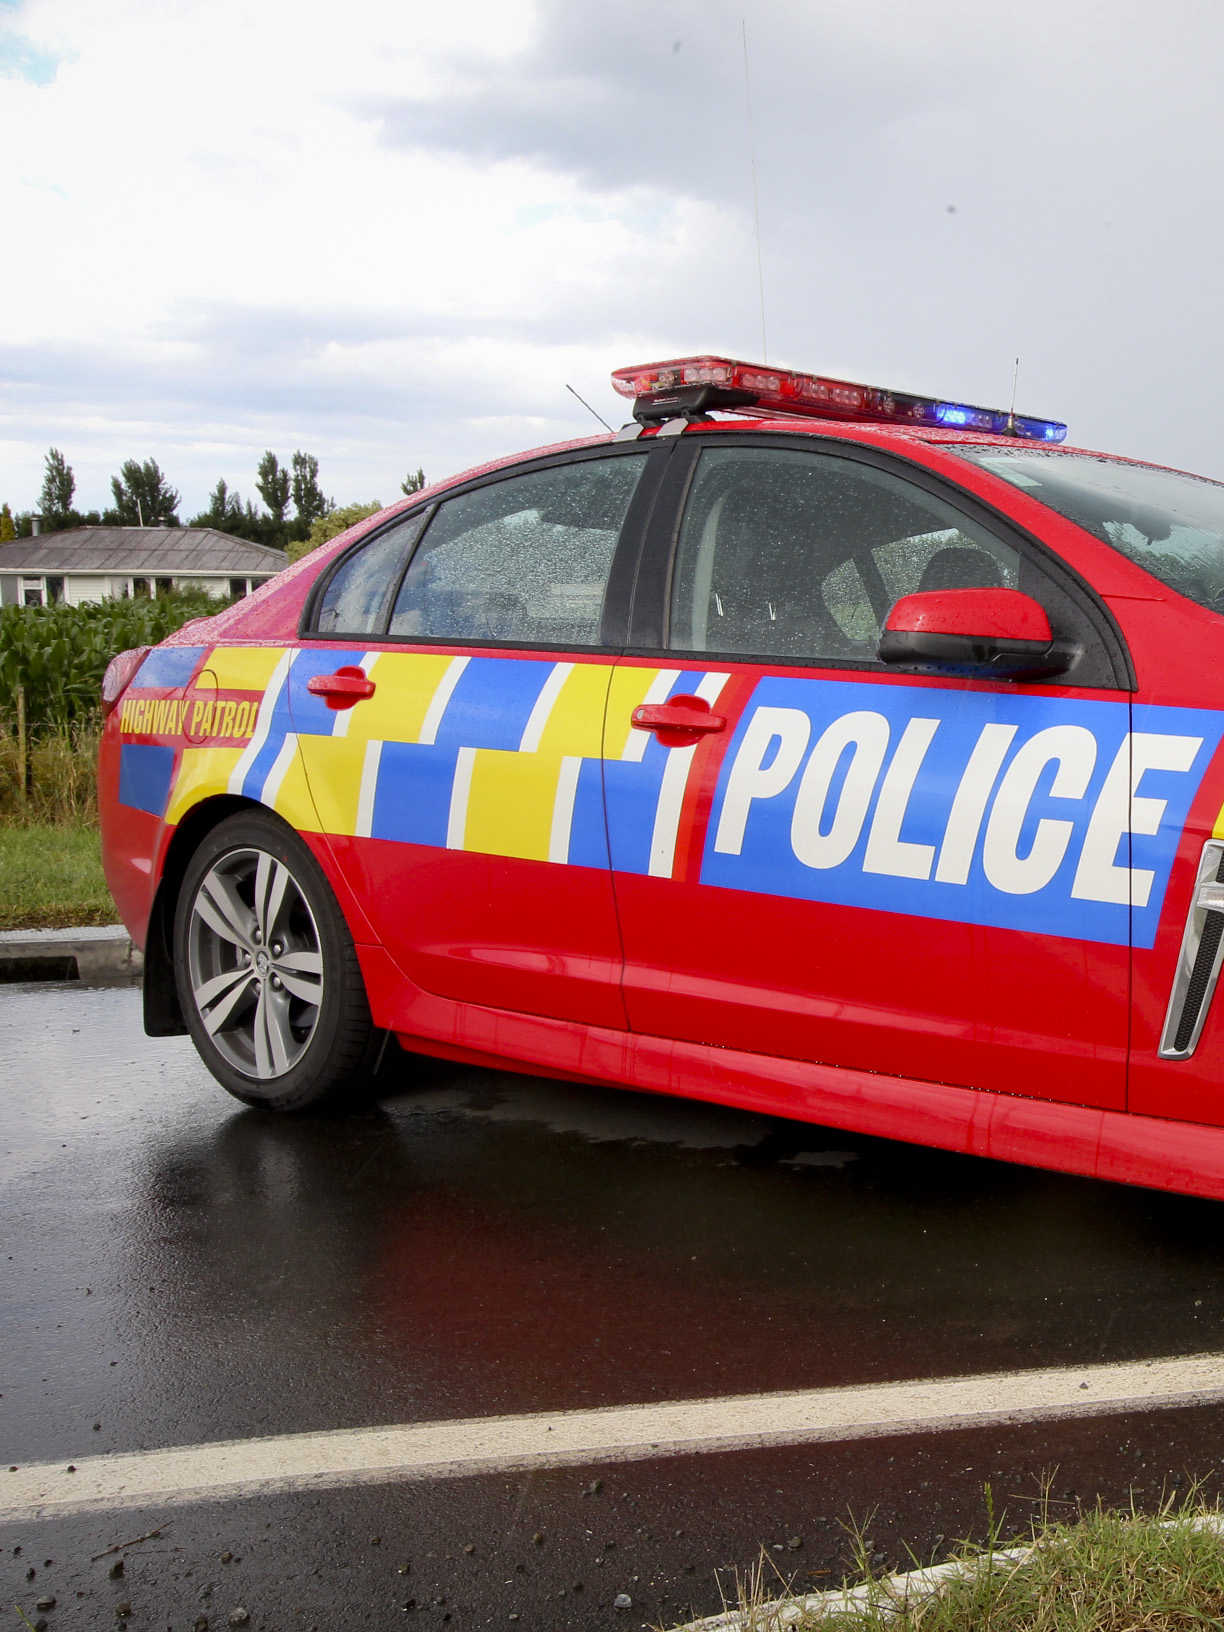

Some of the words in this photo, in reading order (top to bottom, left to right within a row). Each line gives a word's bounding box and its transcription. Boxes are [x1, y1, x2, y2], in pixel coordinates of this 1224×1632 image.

[120, 699, 190, 736] HIGHWAY
[190, 700, 259, 738] PATROL
[714, 706, 1204, 907] POLICE
